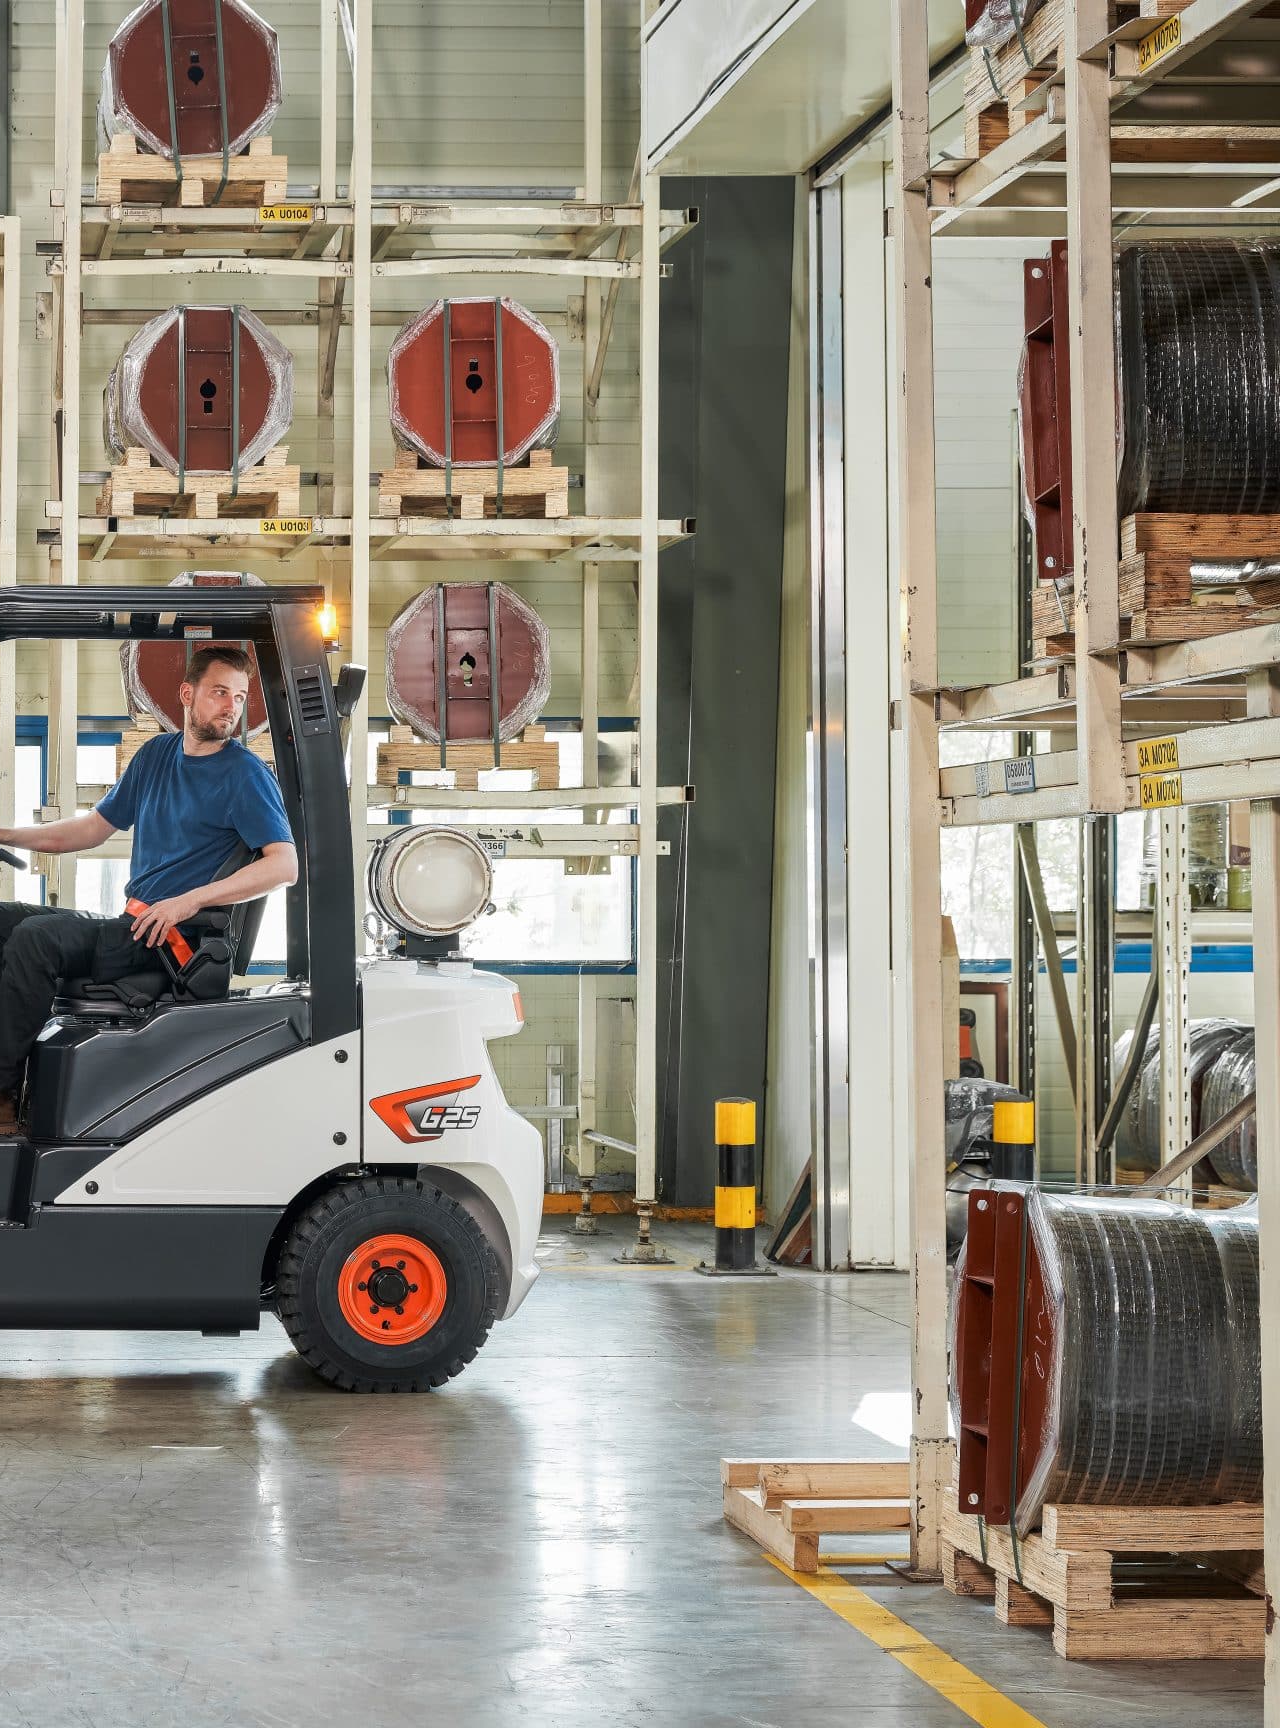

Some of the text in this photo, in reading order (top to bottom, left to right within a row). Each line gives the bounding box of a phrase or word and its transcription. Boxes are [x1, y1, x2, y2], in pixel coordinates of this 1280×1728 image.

[1140, 20, 1180, 65] 3A M0703
[263, 210, 308, 219] 3A U0104
[263, 522, 276, 531] 3A
[1140, 742, 1176, 768] 3A M0702
[1143, 778, 1180, 804] 3A M0701
[420, 1106, 481, 1129] G25
